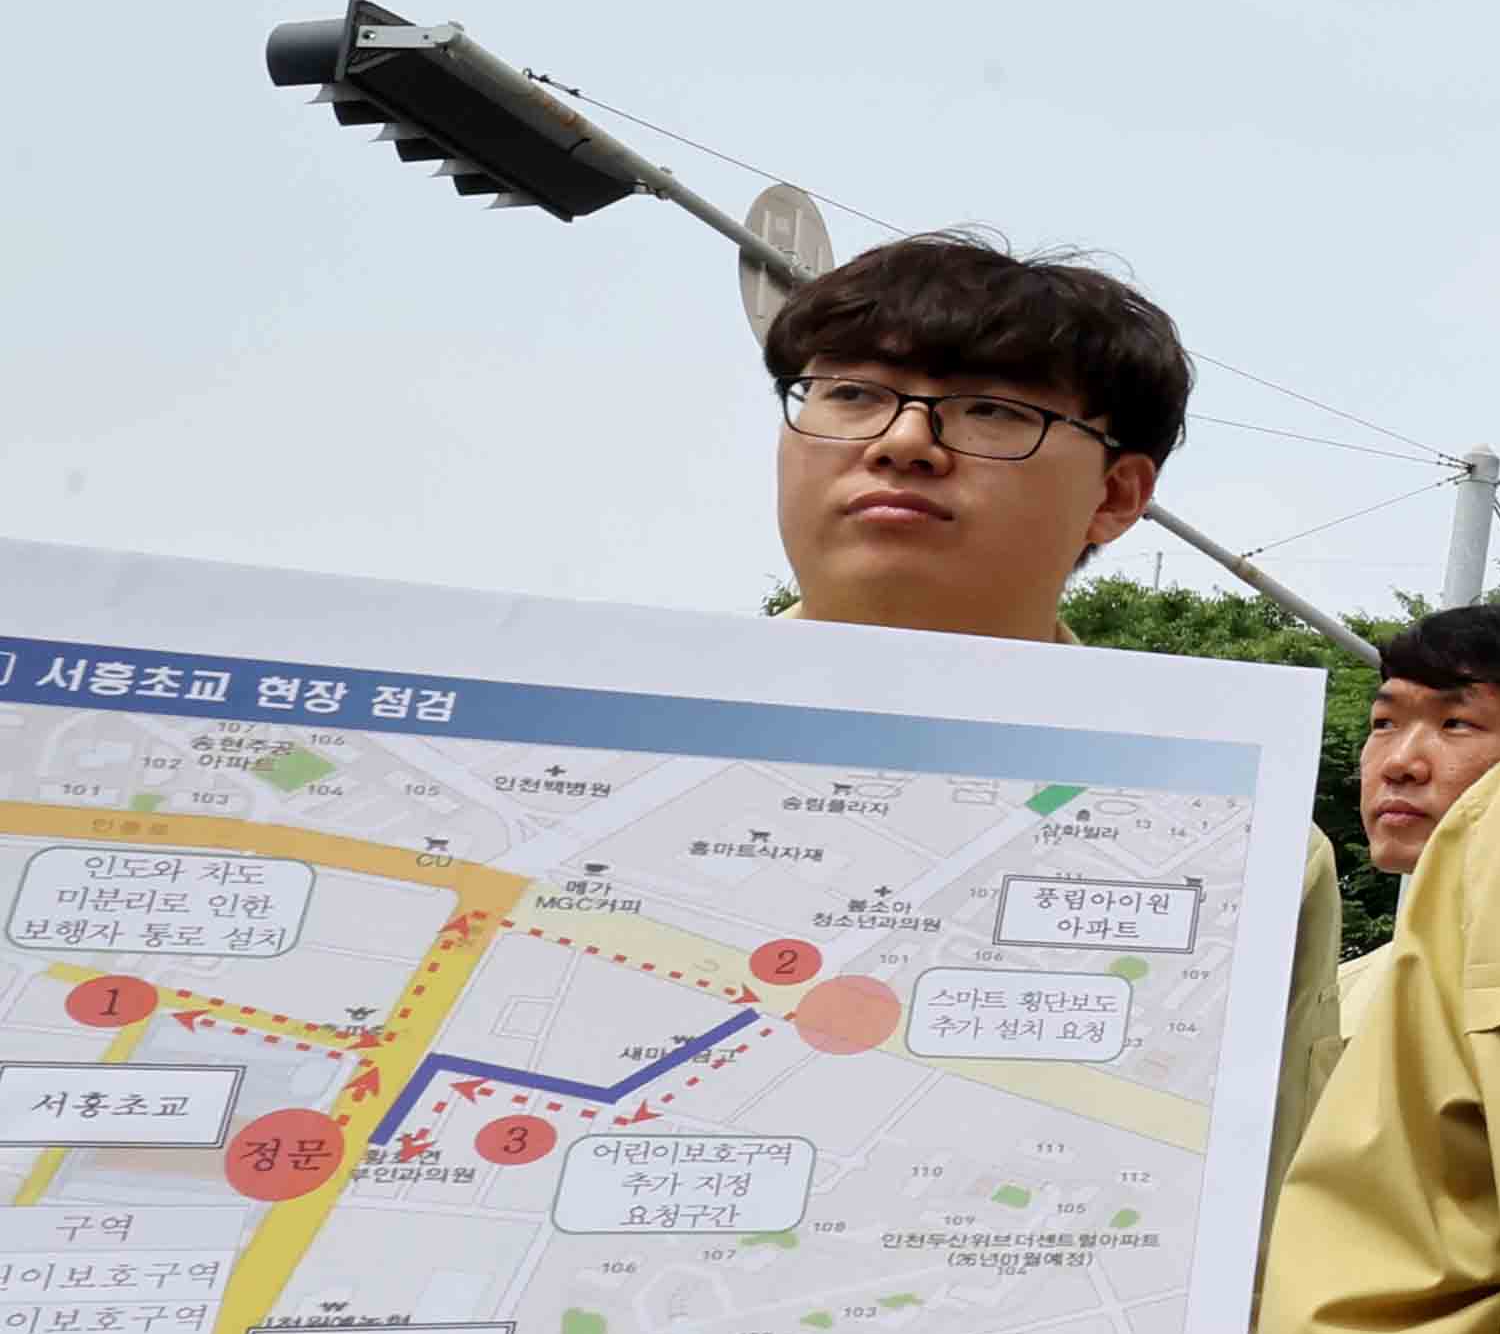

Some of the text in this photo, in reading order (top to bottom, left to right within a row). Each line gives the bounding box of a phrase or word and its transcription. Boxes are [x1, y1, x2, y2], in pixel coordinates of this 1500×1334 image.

[37, 657, 456, 722] 서흥초교 현장 점검
[142, 757, 182, 769] 102
[62, 784, 100, 796] 101
[404, 784, 440, 796] 105
[84, 855, 265, 885] 인도와 차도
[566, 881, 612, 895] 메가
[1033, 886, 1170, 916] 풍림아이원
[57, 887, 273, 919] 미분리로 인한
[16, 918, 287, 952] 보행자 통로 설치
[1057, 917, 1140, 940] 아파트
[775, 948, 799, 975] 2
[99, 988, 119, 1017] 1
[928, 988, 1119, 1014] 스마트 횡단보도
[928, 1016, 1106, 1044] 추가 설치 요청
[502, 1126, 528, 1154] 3
[593, 1141, 792, 1165] 어린이보호구역
[240, 1137, 333, 1172] 정문
[622, 1172, 751, 1197] 추가 지정
[56, 1214, 134, 1241] 구역
[620, 1203, 740, 1228] 요청구간
